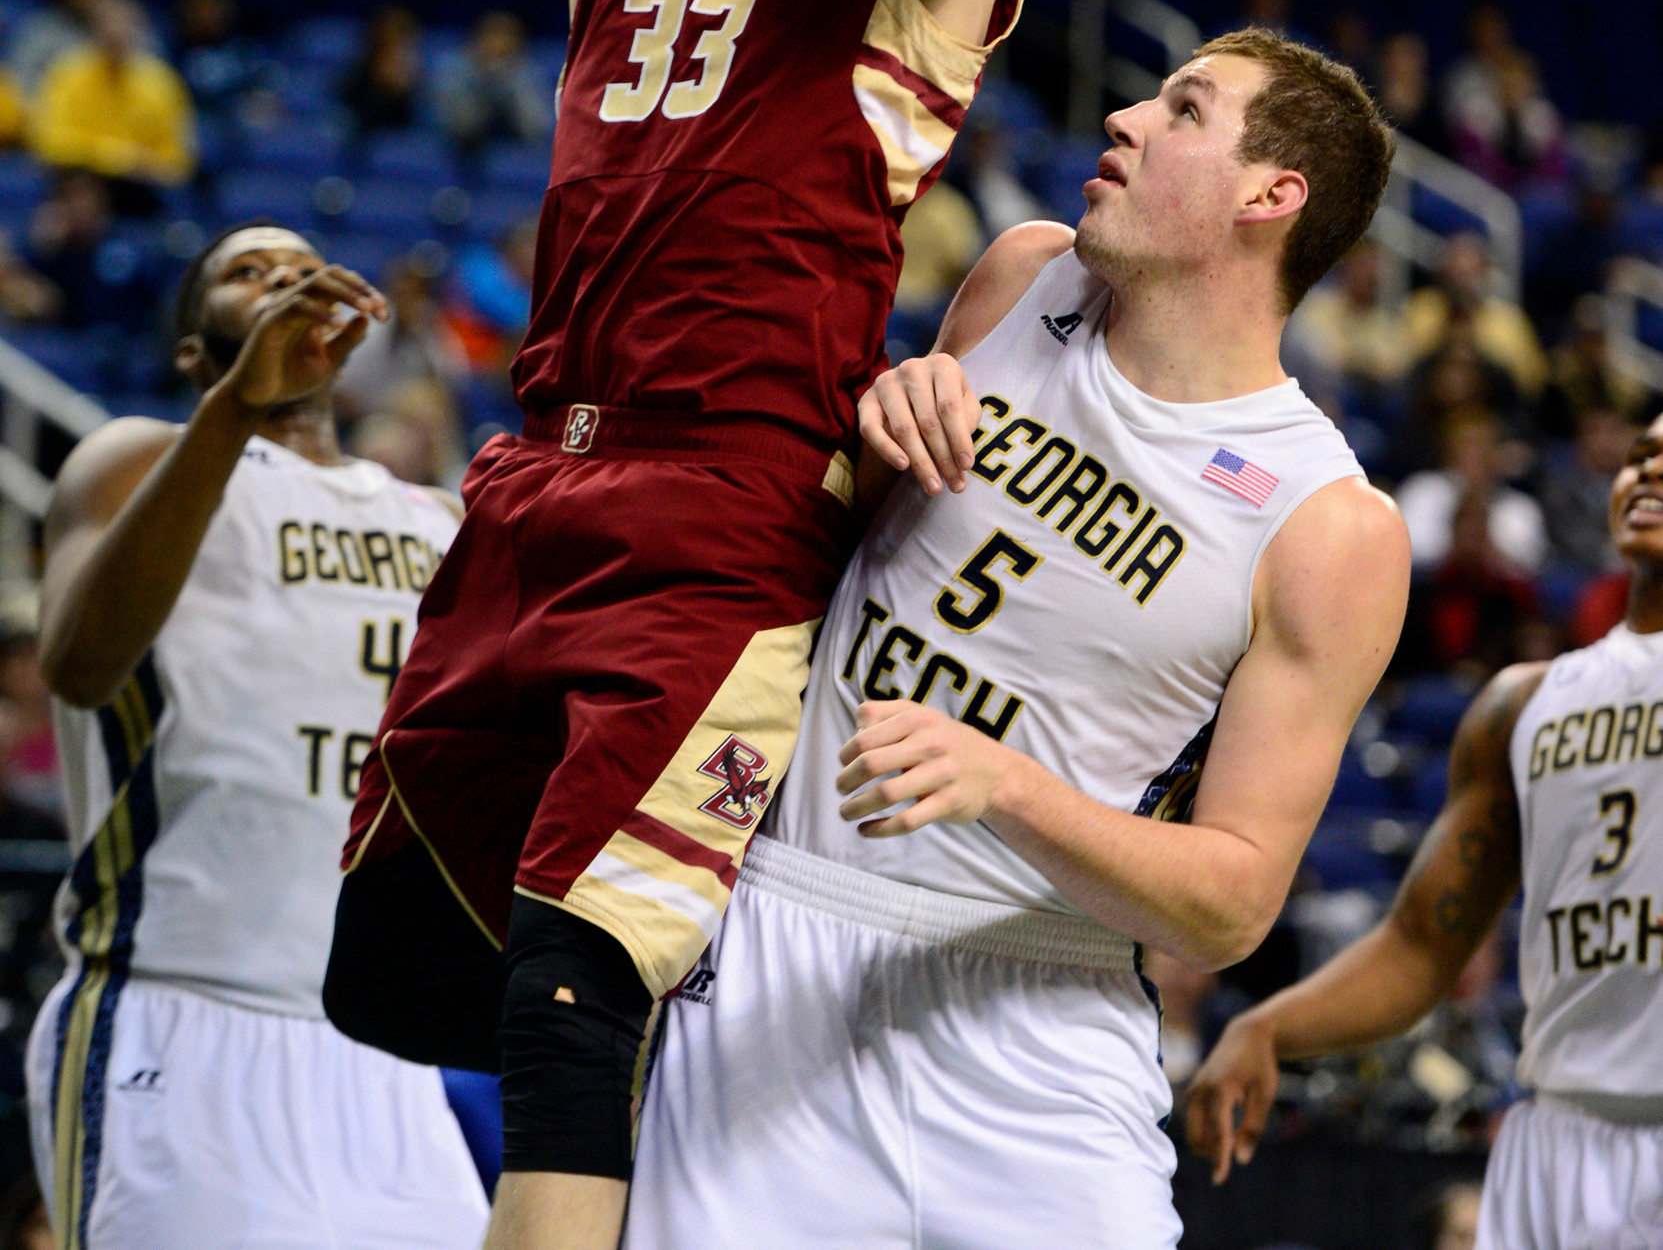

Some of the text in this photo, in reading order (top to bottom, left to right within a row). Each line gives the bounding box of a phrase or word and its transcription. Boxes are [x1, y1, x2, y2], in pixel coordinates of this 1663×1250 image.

[932, 527, 1045, 636] 5
[361, 618, 404, 706] 4
[840, 597, 1025, 743] TECH
[298, 723, 376, 803] TE
[1590, 787, 1637, 880] 3
